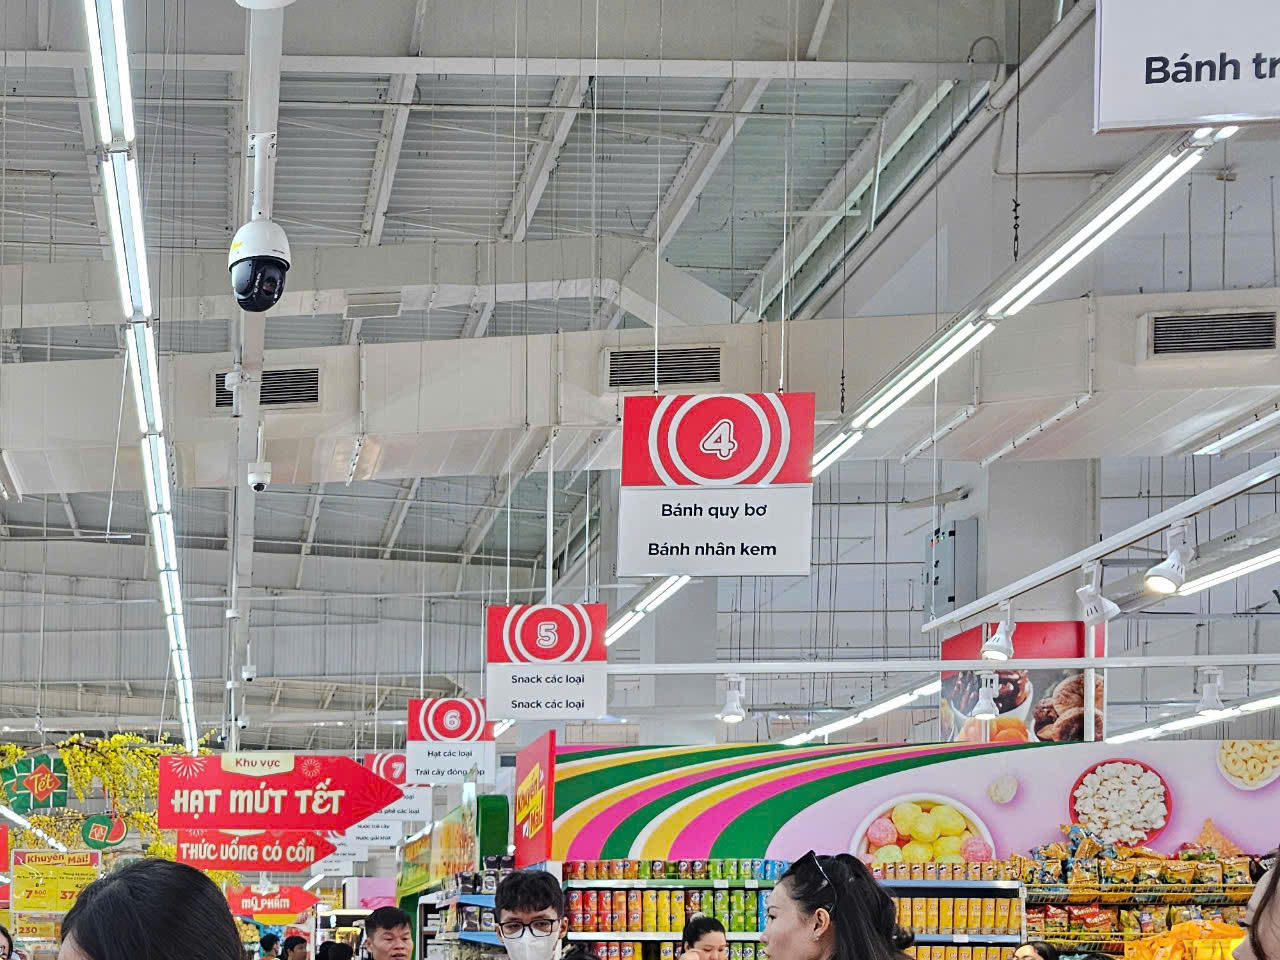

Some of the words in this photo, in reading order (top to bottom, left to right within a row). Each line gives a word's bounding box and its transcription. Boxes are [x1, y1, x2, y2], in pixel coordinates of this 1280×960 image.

[1144, 52, 1241, 85] Bánh
[699, 418, 738, 460] 4
[661, 502, 704, 517] Bánh
[707, 506, 740, 521] quy
[744, 502, 768, 517] bơ
[647, 541, 690, 556] Bánh
[694, 541, 736, 556] nhân
[740, 541, 777, 556] kem
[536, 621, 559, 648] 5
[511, 674, 543, 684] Snack
[544, 673, 563, 684] các
[565, 674, 585, 686] loại
[511, 699, 543, 709] Snack
[544, 698, 563, 709] các
[565, 699, 585, 711] loại
[443, 709, 461, 731] 6
[235, 757, 258, 768] Khu
[259, 758, 281, 770] vực
[427, 750, 442, 759] Hạt
[458, 750, 473, 759] loại
[391, 761, 405, 779] 7
[415, 768, 430, 776] Trái
[431, 768, 446, 778] cây
[29, 769, 55, 793] Tết
[171, 788, 222, 820] HẠT
[229, 781, 288, 815] MỨT
[294, 778, 346, 815] TẾT
[180, 838, 219, 861] THỨC
[220, 836, 259, 862] UỐNG
[262, 839, 282, 862] CÓ
[286, 838, 316, 863] CỒN
